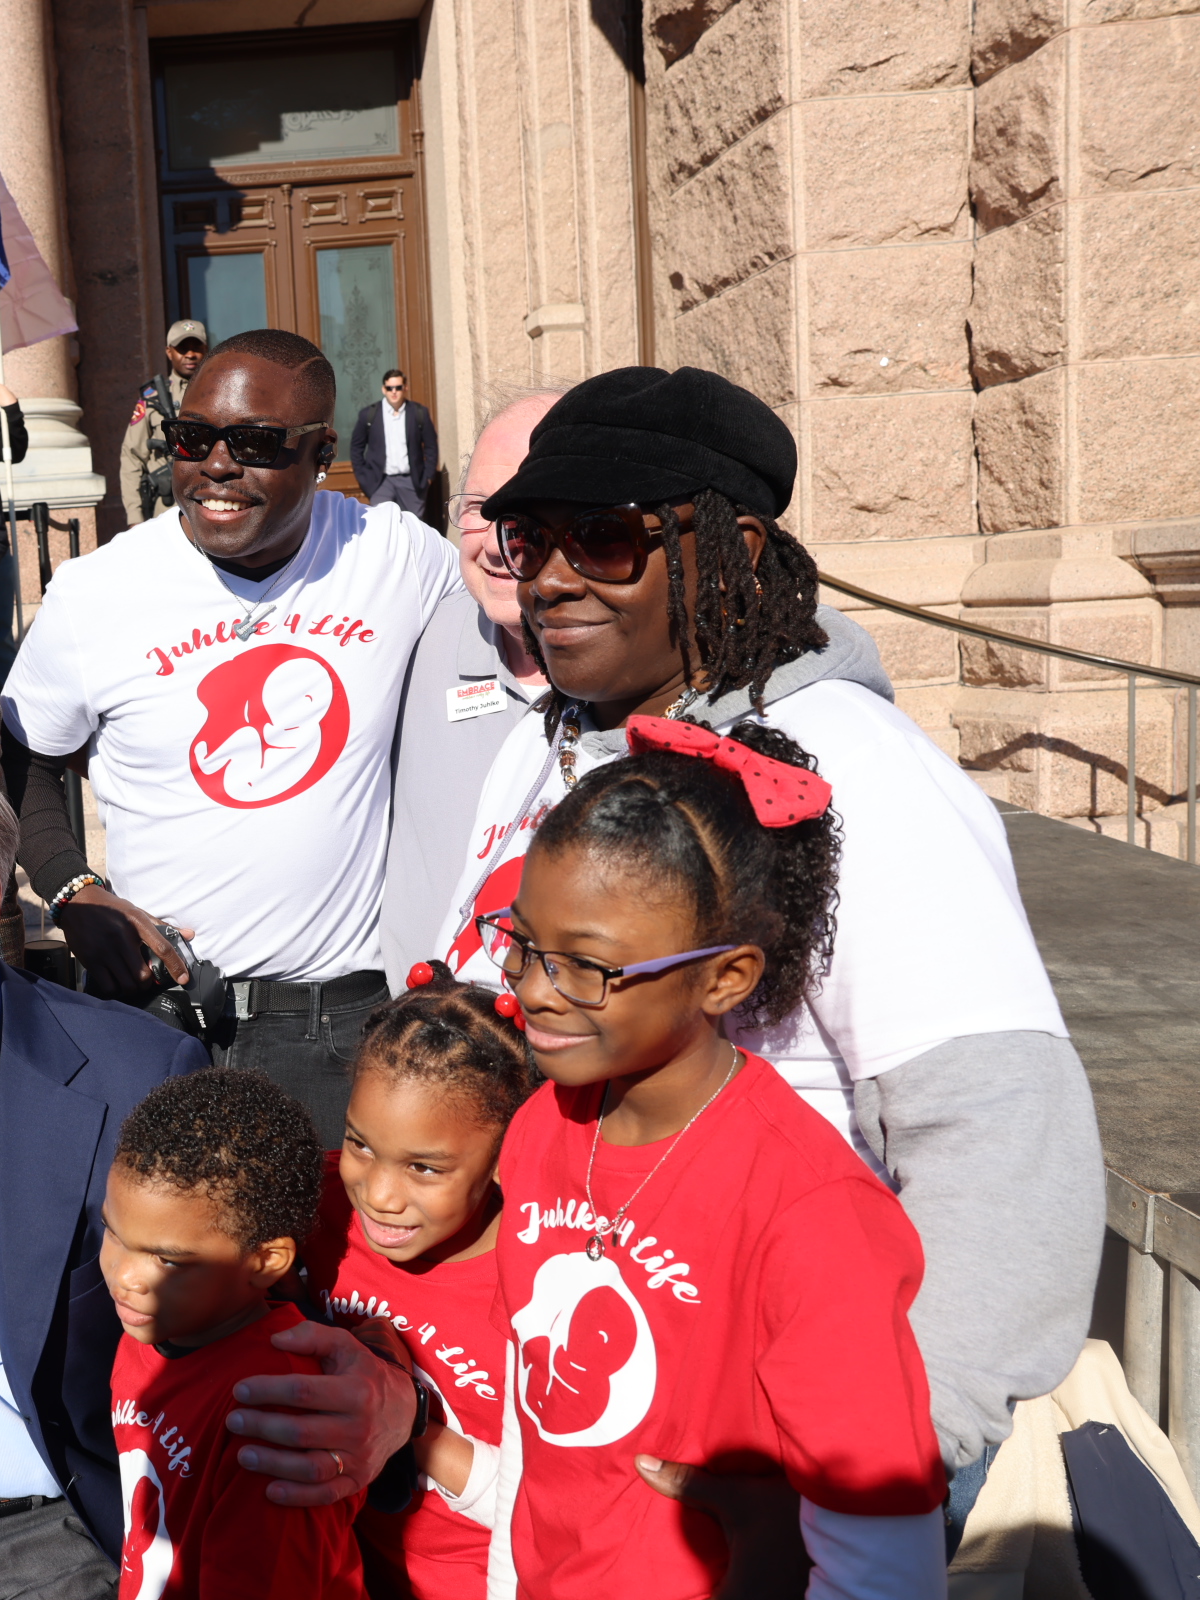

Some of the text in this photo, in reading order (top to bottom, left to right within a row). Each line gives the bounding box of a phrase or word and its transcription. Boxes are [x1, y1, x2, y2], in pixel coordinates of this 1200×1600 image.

[284, 613, 301, 634] 4
[308, 614, 379, 647] Life
[455, 700, 499, 714] Timothy Juhlke
[457, 681, 495, 698] EMBRACE
[516, 1196, 701, 1304] Juhlke 4 Life
[417, 1322, 436, 1345] 4
[435, 1343, 498, 1401] Life
[159, 1426, 194, 1478] Life
